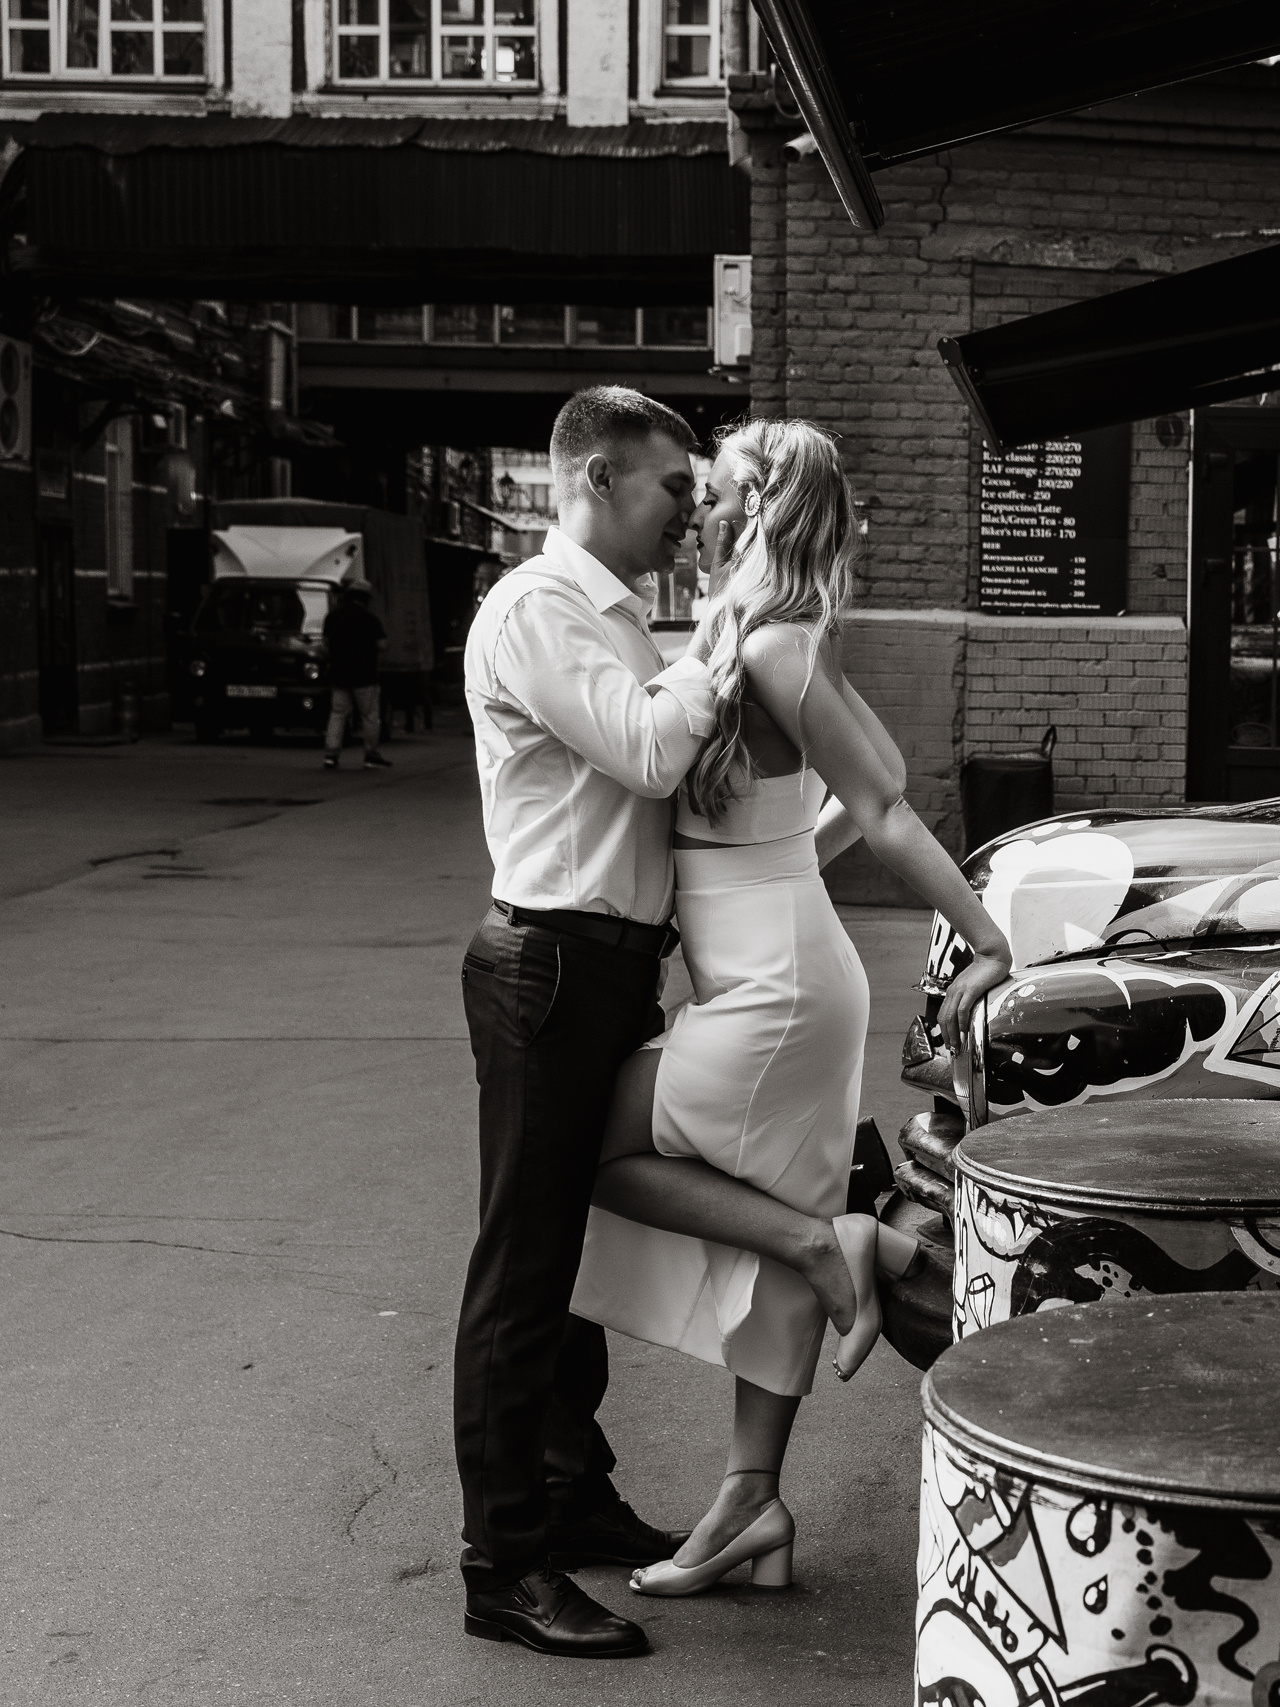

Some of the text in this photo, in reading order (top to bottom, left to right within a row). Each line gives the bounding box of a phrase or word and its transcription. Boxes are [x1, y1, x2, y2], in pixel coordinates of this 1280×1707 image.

[1005, 452, 1036, 463] classic
[1005, 467, 1038, 479] orange
[982, 476, 1011, 487] Cocoa
[982, 488, 996, 499] Ice
[998, 490, 1027, 500] coffee
[981, 501, 1062, 514] Cappuccino/Latte
[1039, 515, 1056, 526] Tea
[1012, 529, 1028, 538] tea
[1060, 529, 1076, 539] 170
